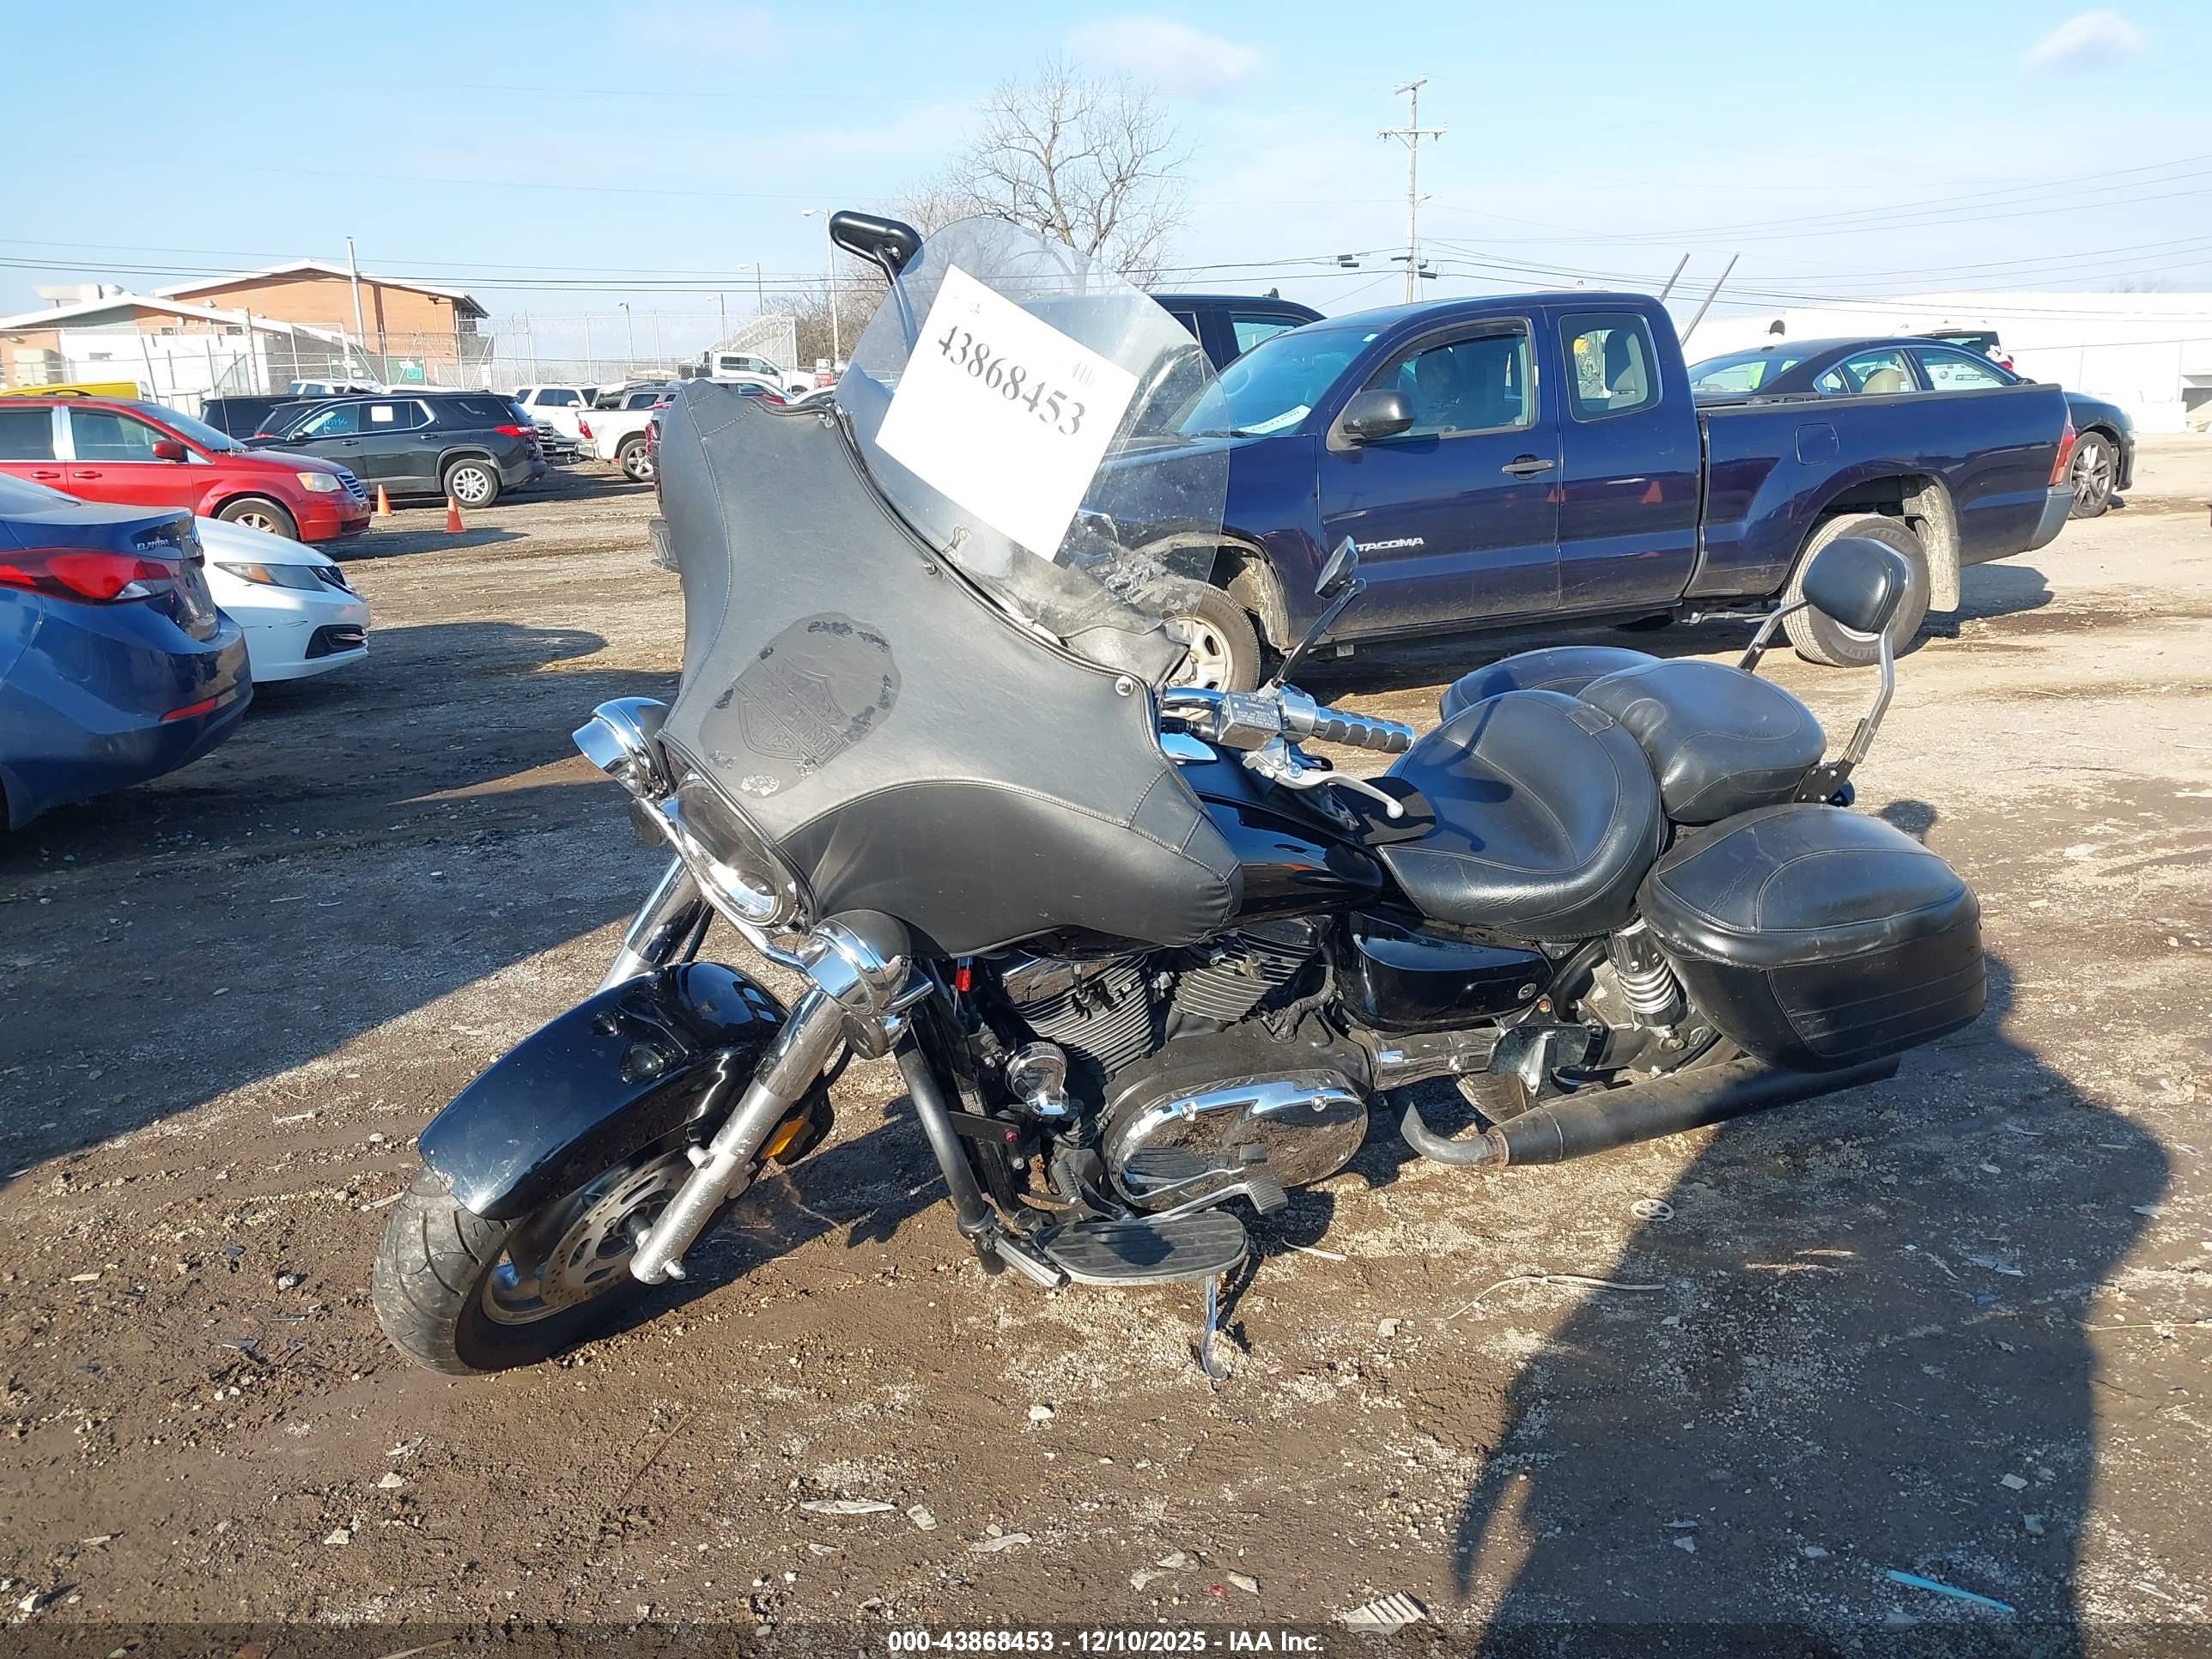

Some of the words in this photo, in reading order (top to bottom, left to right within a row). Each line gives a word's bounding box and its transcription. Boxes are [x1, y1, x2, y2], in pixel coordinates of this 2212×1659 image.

[938, 325, 1086, 436] 43868453
[137, 538, 170, 550] ELANTRA
[1355, 537, 1425, 552] TACOMA
